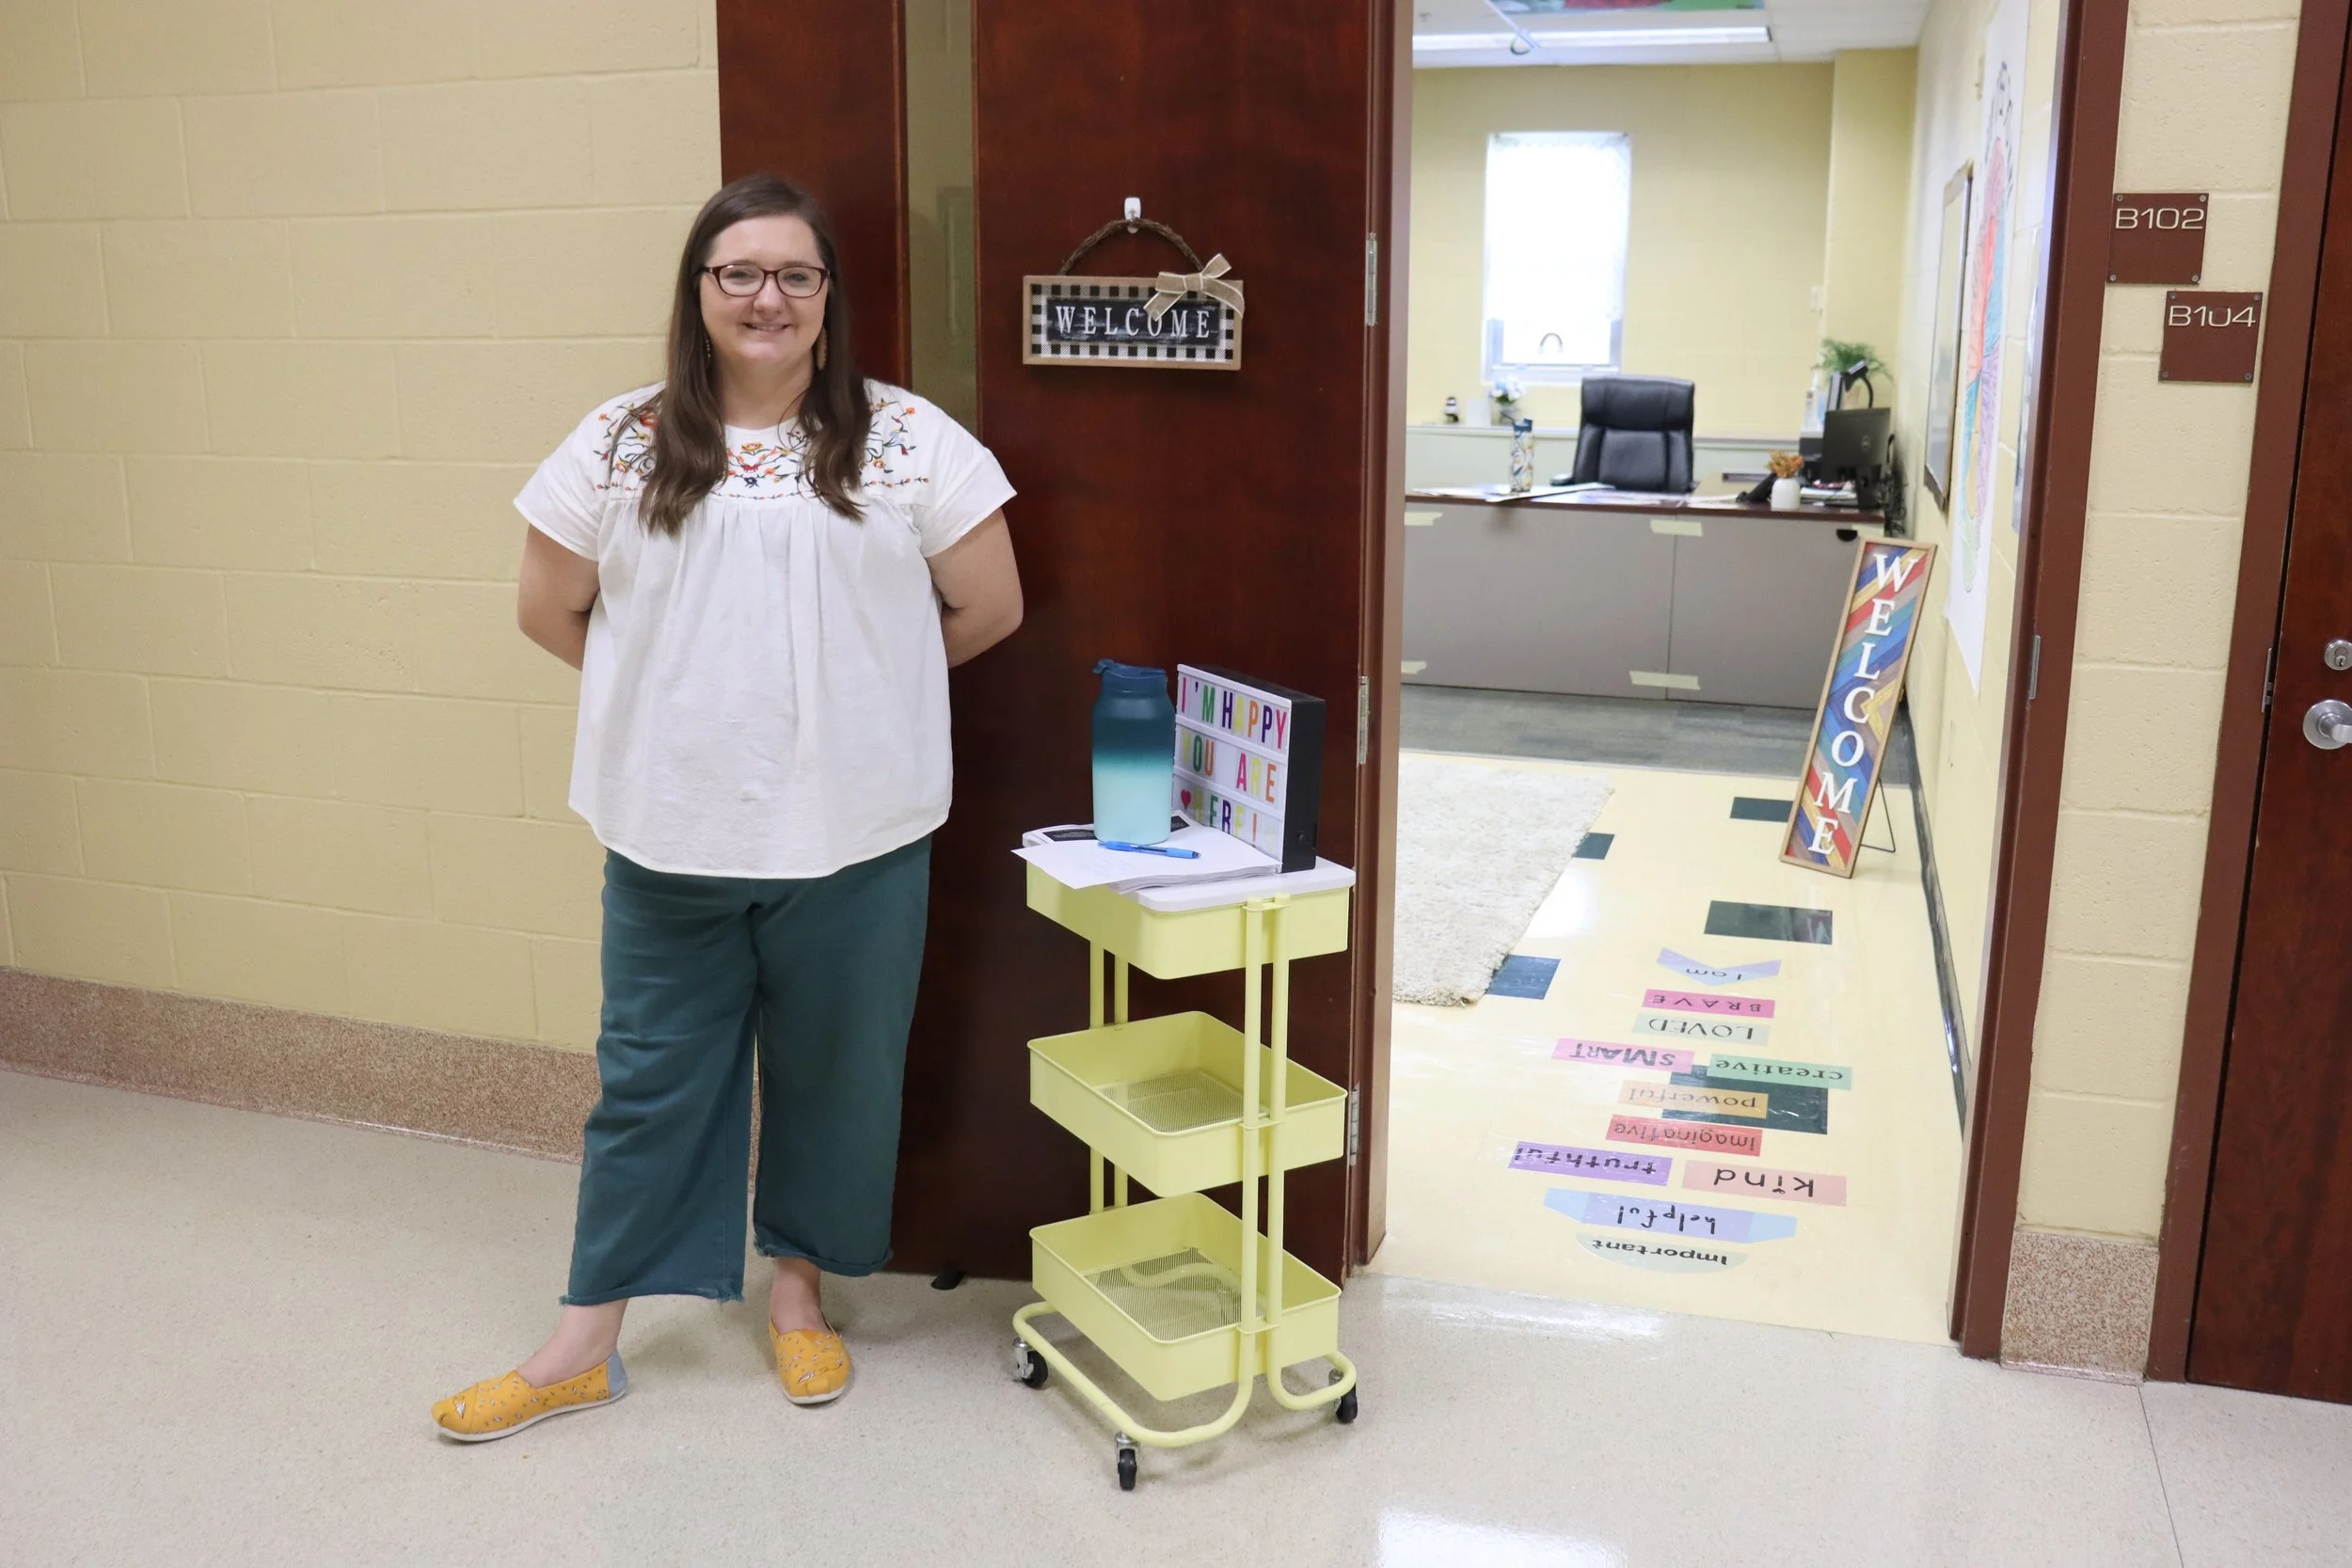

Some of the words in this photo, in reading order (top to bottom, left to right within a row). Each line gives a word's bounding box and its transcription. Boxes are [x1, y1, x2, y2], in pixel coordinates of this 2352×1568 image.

[2115, 207, 2205, 230] B102
[1055, 305, 1211, 339] WELCOME
[2168, 305, 2257, 327] B104
[1807, 552, 1919, 855] WELCOME
[1221, 689, 1288, 750] HAPPY
[1181, 729, 1216, 776] YOU
[1235, 752, 1279, 803] ARE
[1686, 967, 1727, 978] am
[1652, 994, 1762, 1013] BRAVE
[1648, 1018, 1755, 1040] LOVED
[1715, 1059, 1844, 1081] creative
[1628, 1086, 1758, 1109] powerful
[1614, 1122, 1756, 1152] imaginative
[1514, 1147, 1657, 1175] truthful
[1616, 1205, 1717, 1235] helpful
[1592, 1239, 1728, 1266] Important
